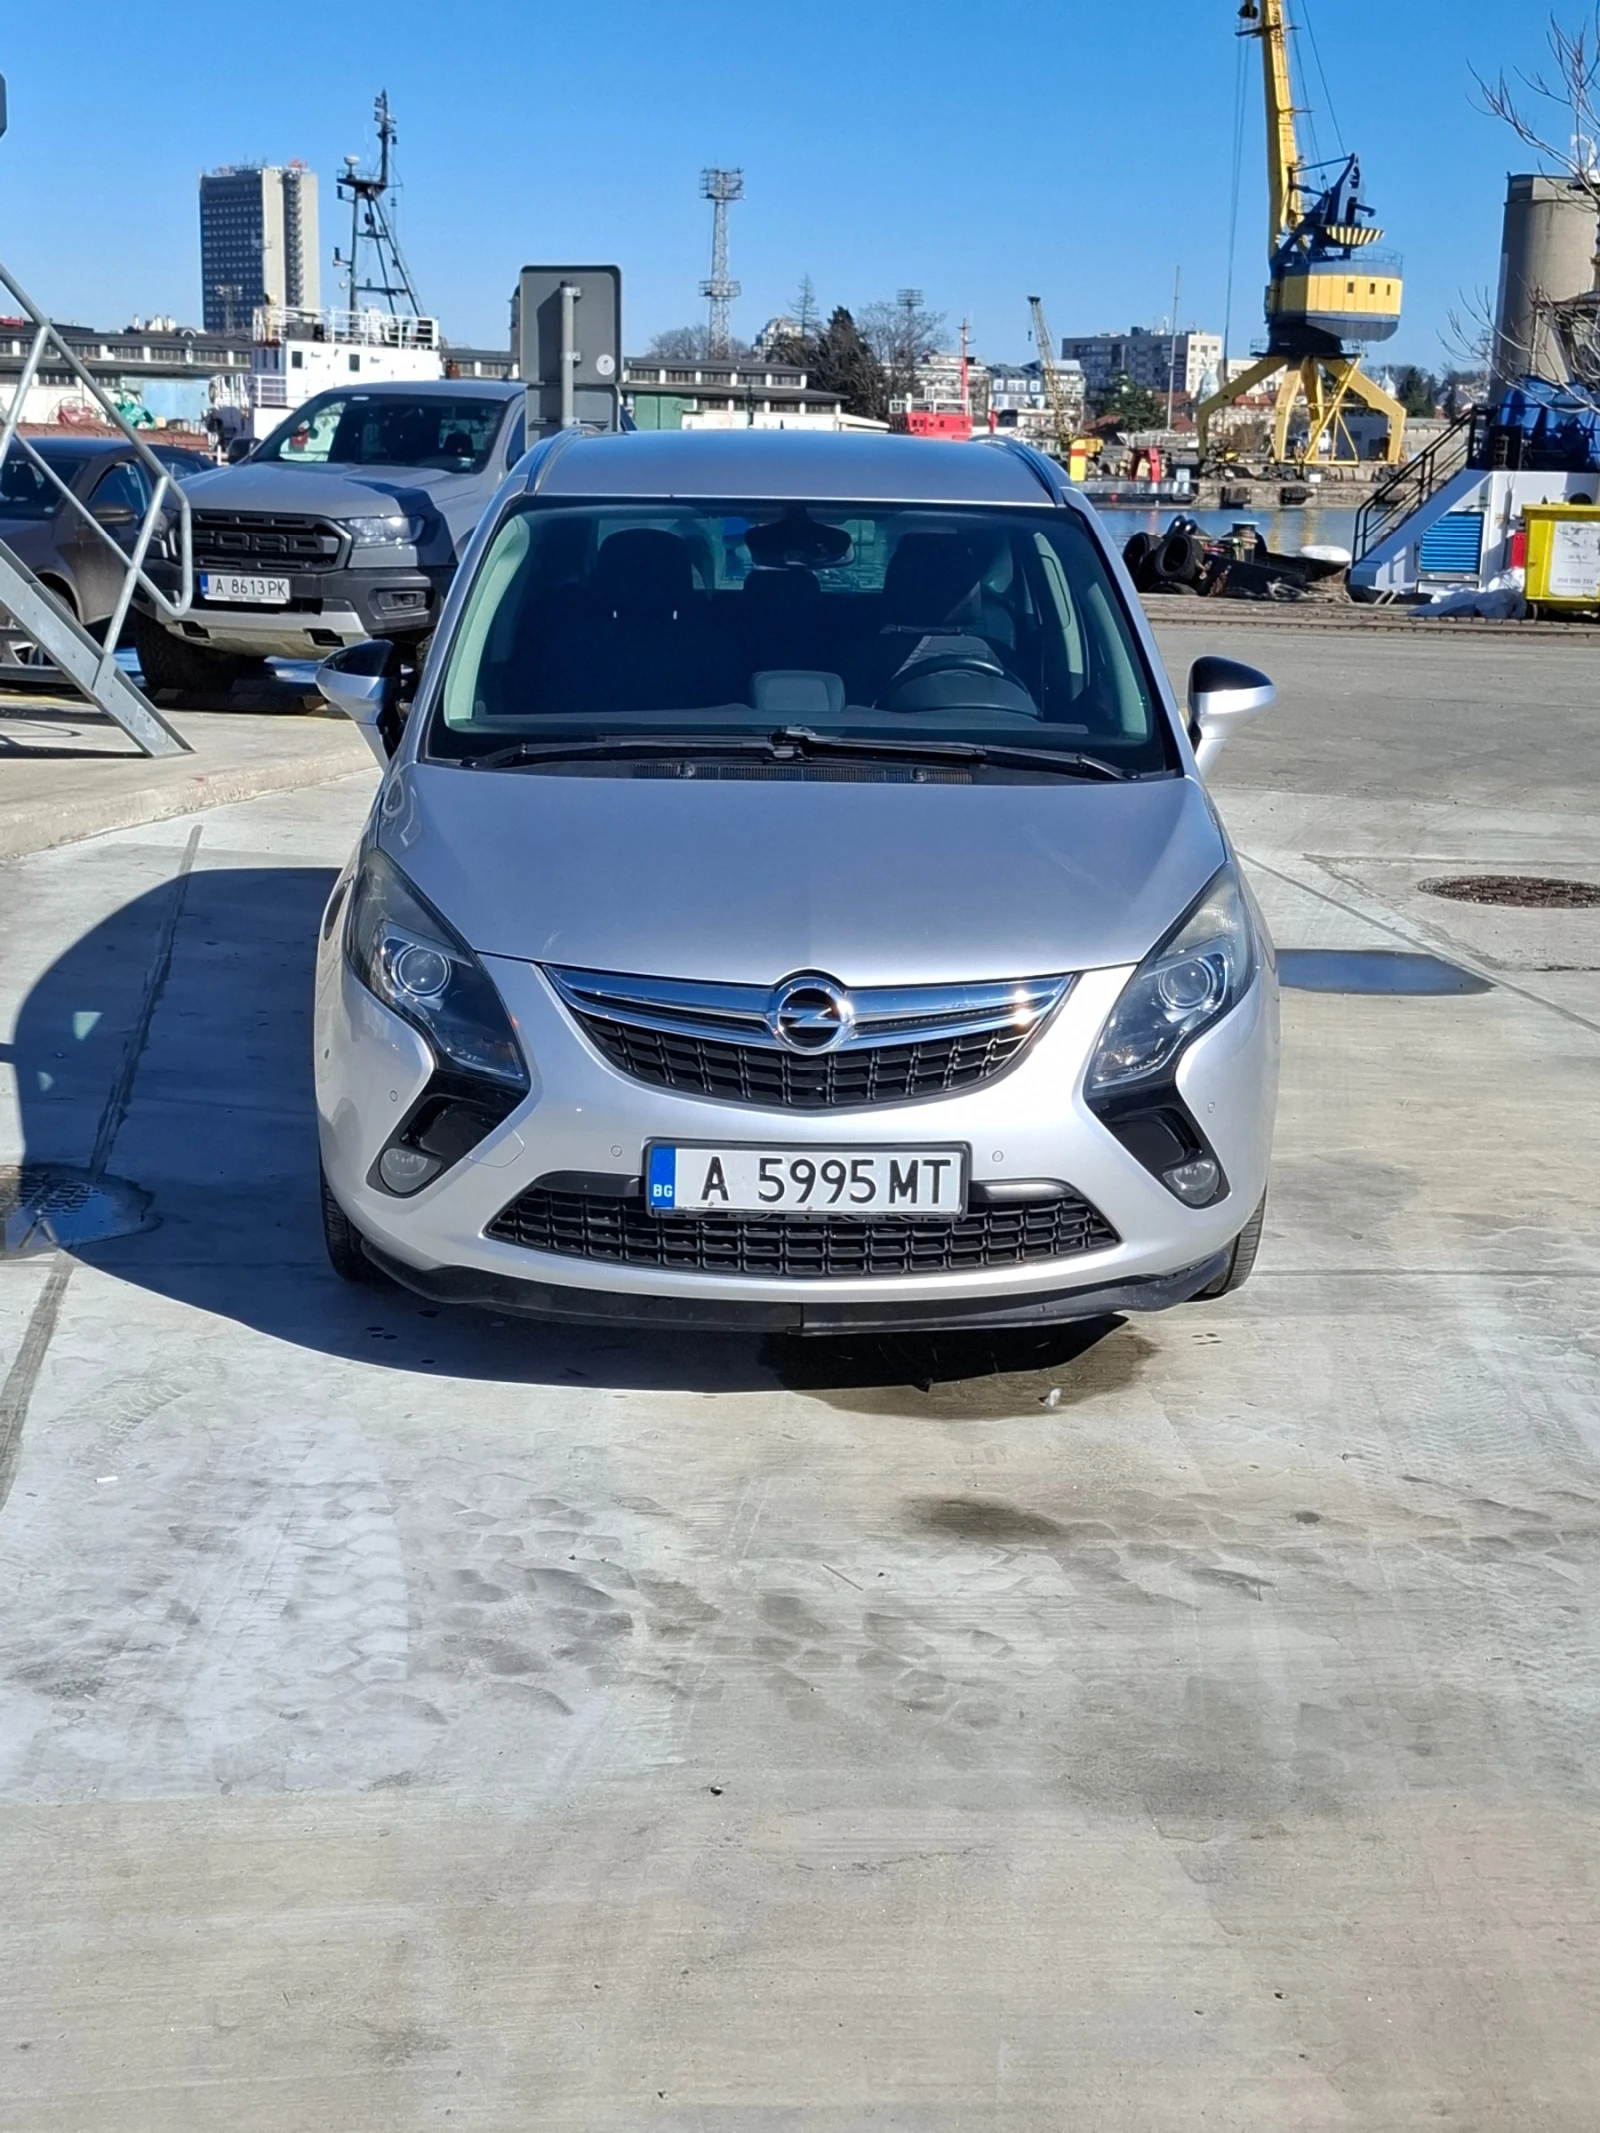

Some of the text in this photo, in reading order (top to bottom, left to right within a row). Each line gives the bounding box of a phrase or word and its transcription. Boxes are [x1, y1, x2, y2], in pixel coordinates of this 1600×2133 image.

[215, 577, 286, 597] A 8613 PK
[652, 1183, 674, 1198] BG
[700, 1156, 952, 1205] A 5995 MT
